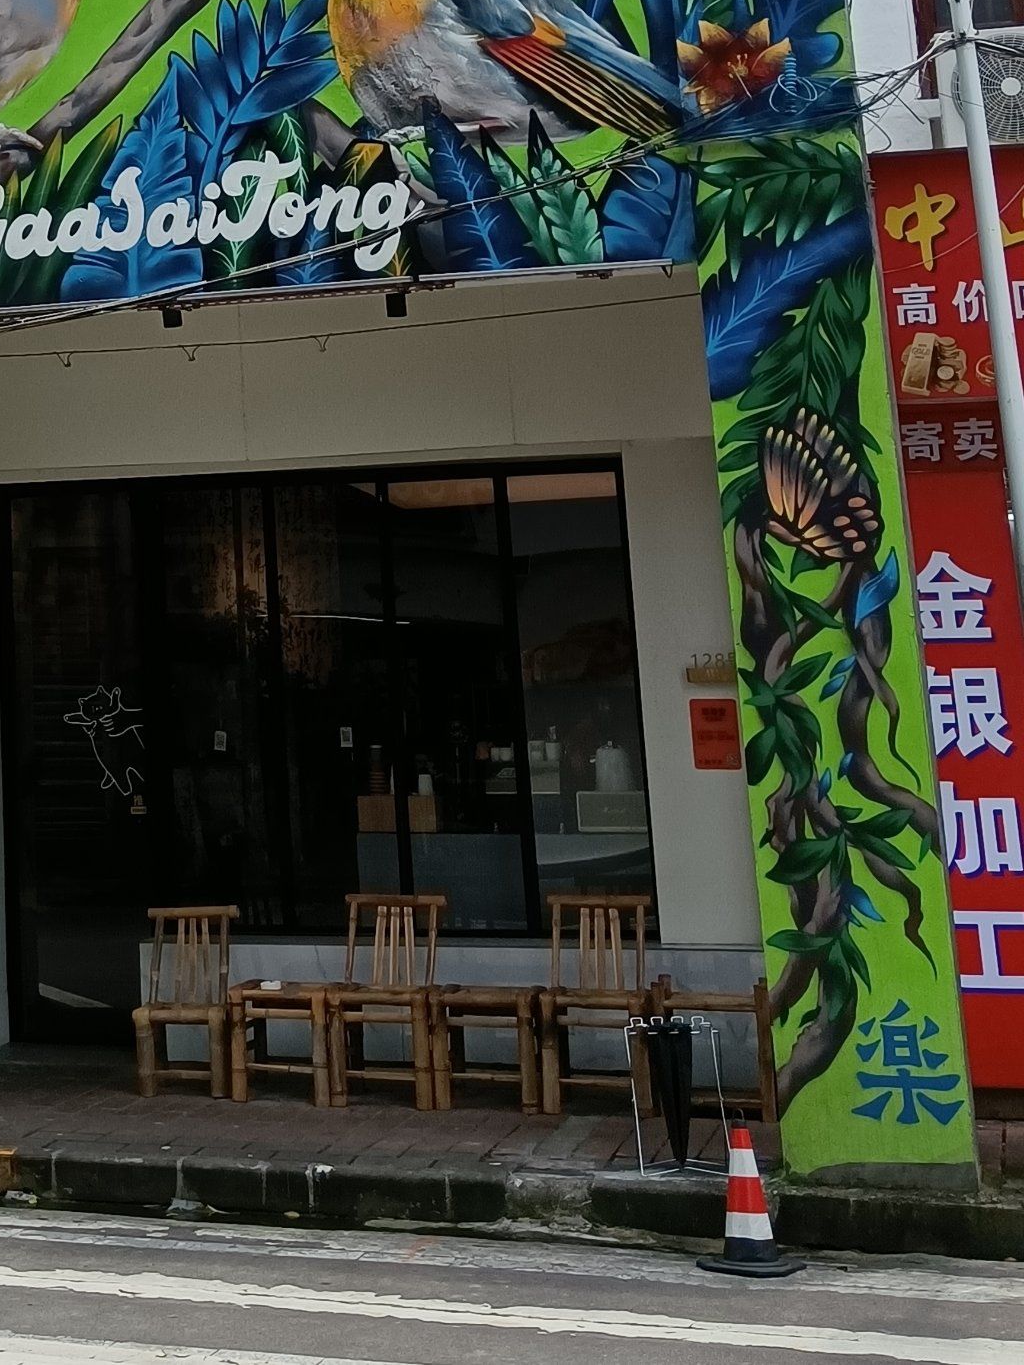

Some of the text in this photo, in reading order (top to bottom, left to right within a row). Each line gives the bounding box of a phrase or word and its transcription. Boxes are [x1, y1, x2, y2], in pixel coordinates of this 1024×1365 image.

[901, 418, 997, 462] 寄卖
[916, 551, 1024, 991] 金银加工
